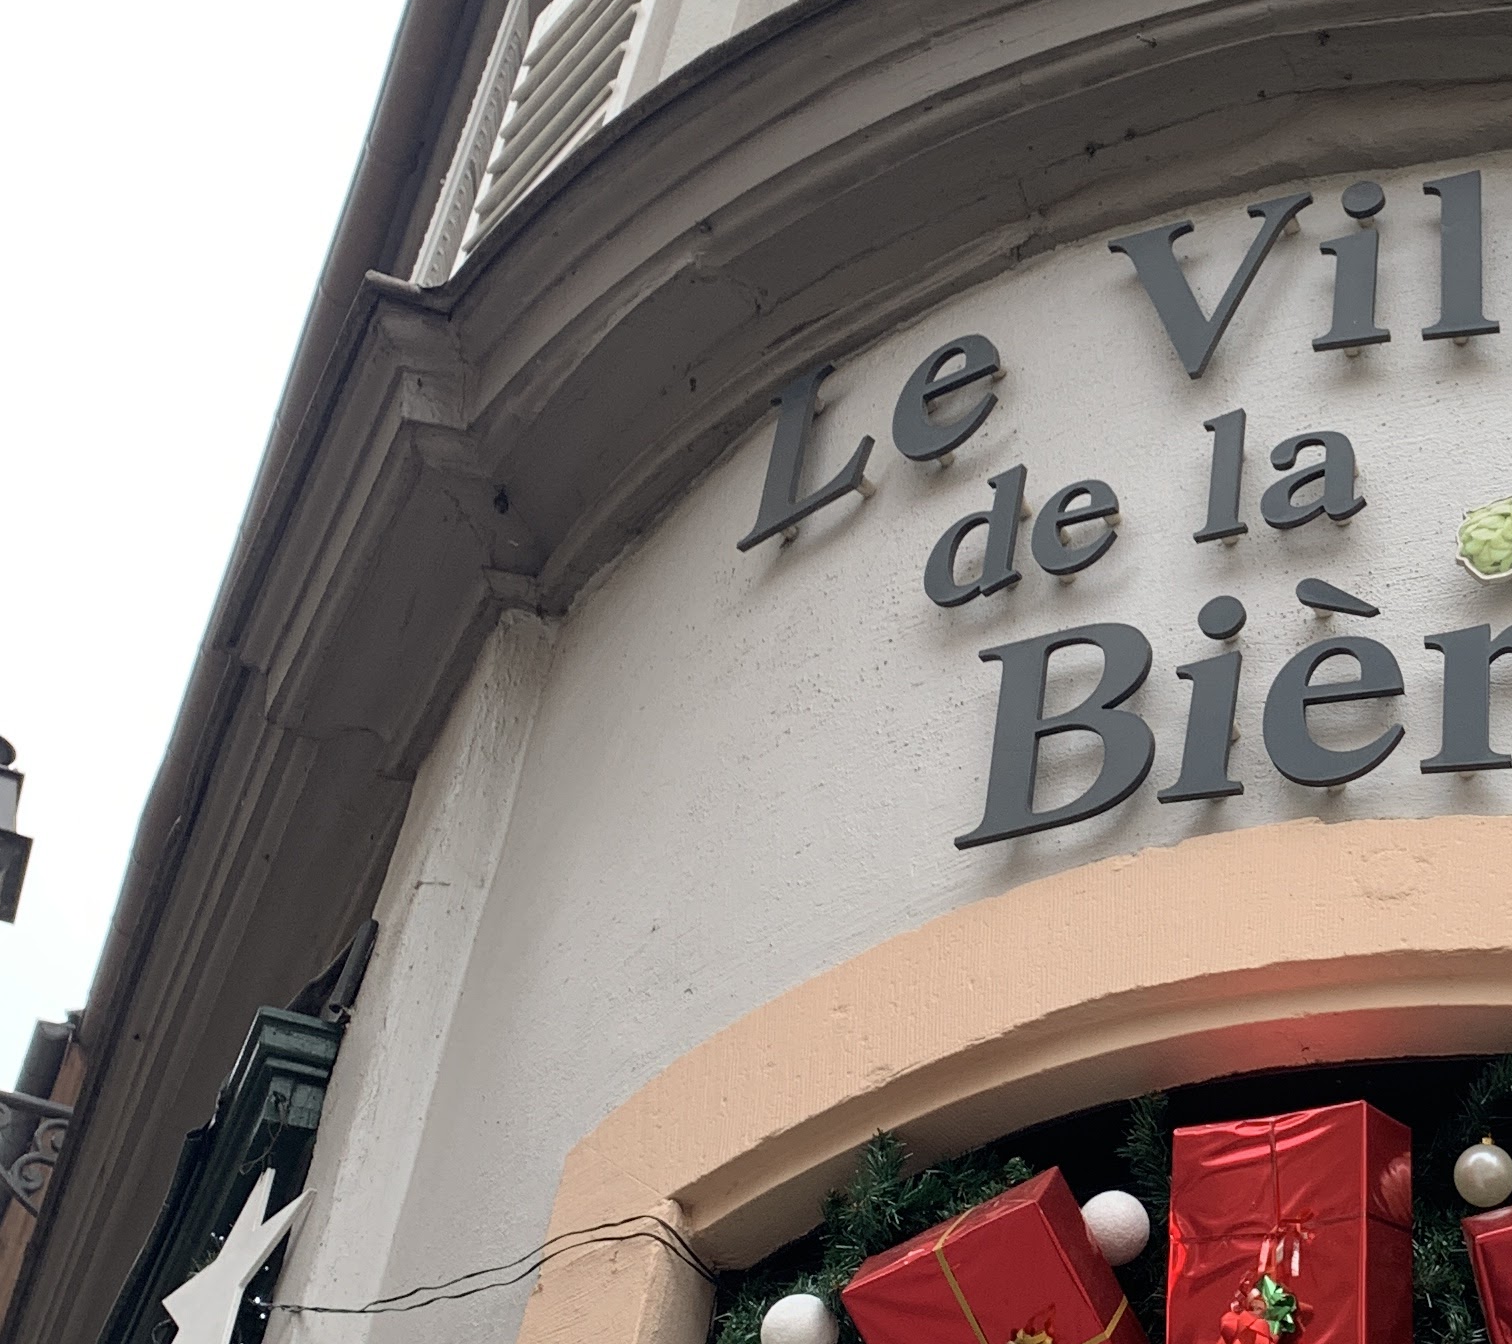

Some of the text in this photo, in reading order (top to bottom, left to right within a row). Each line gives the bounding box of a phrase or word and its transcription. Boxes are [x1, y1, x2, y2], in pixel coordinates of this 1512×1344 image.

[736, 333, 1003, 552] Le
[924, 408, 1367, 609] de la
